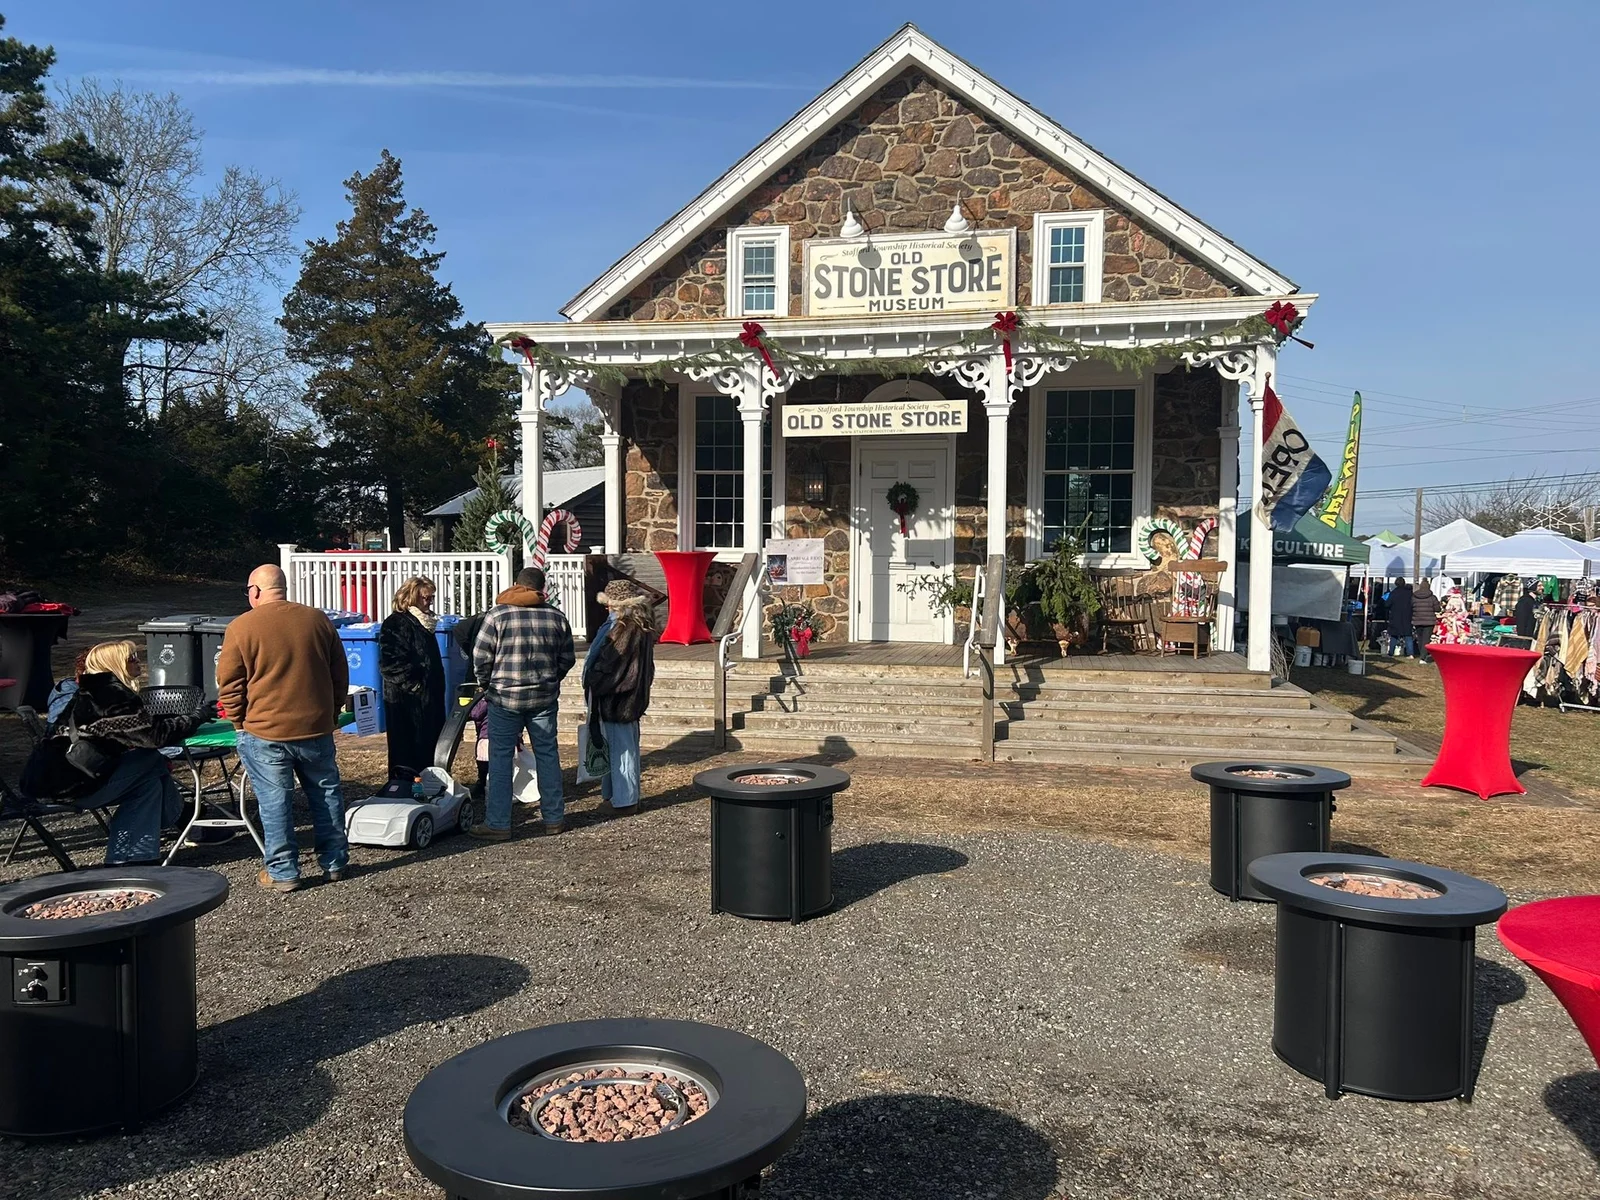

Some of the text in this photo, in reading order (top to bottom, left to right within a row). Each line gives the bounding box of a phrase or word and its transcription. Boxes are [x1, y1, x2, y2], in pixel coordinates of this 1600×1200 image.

[842, 245, 870, 257] Stafford
[873, 243, 907, 252] Township
[946, 241, 973, 251] Society
[890, 251, 923, 265] OLD
[814, 253, 1002, 299] STONE STORE
[869, 297, 944, 312] MUSEUM
[817, 402, 930, 414] Stafford Township Historical Society
[787, 410, 962, 430] OLD STONE STORE
[1273, 539, 1344, 558] CULTURE
